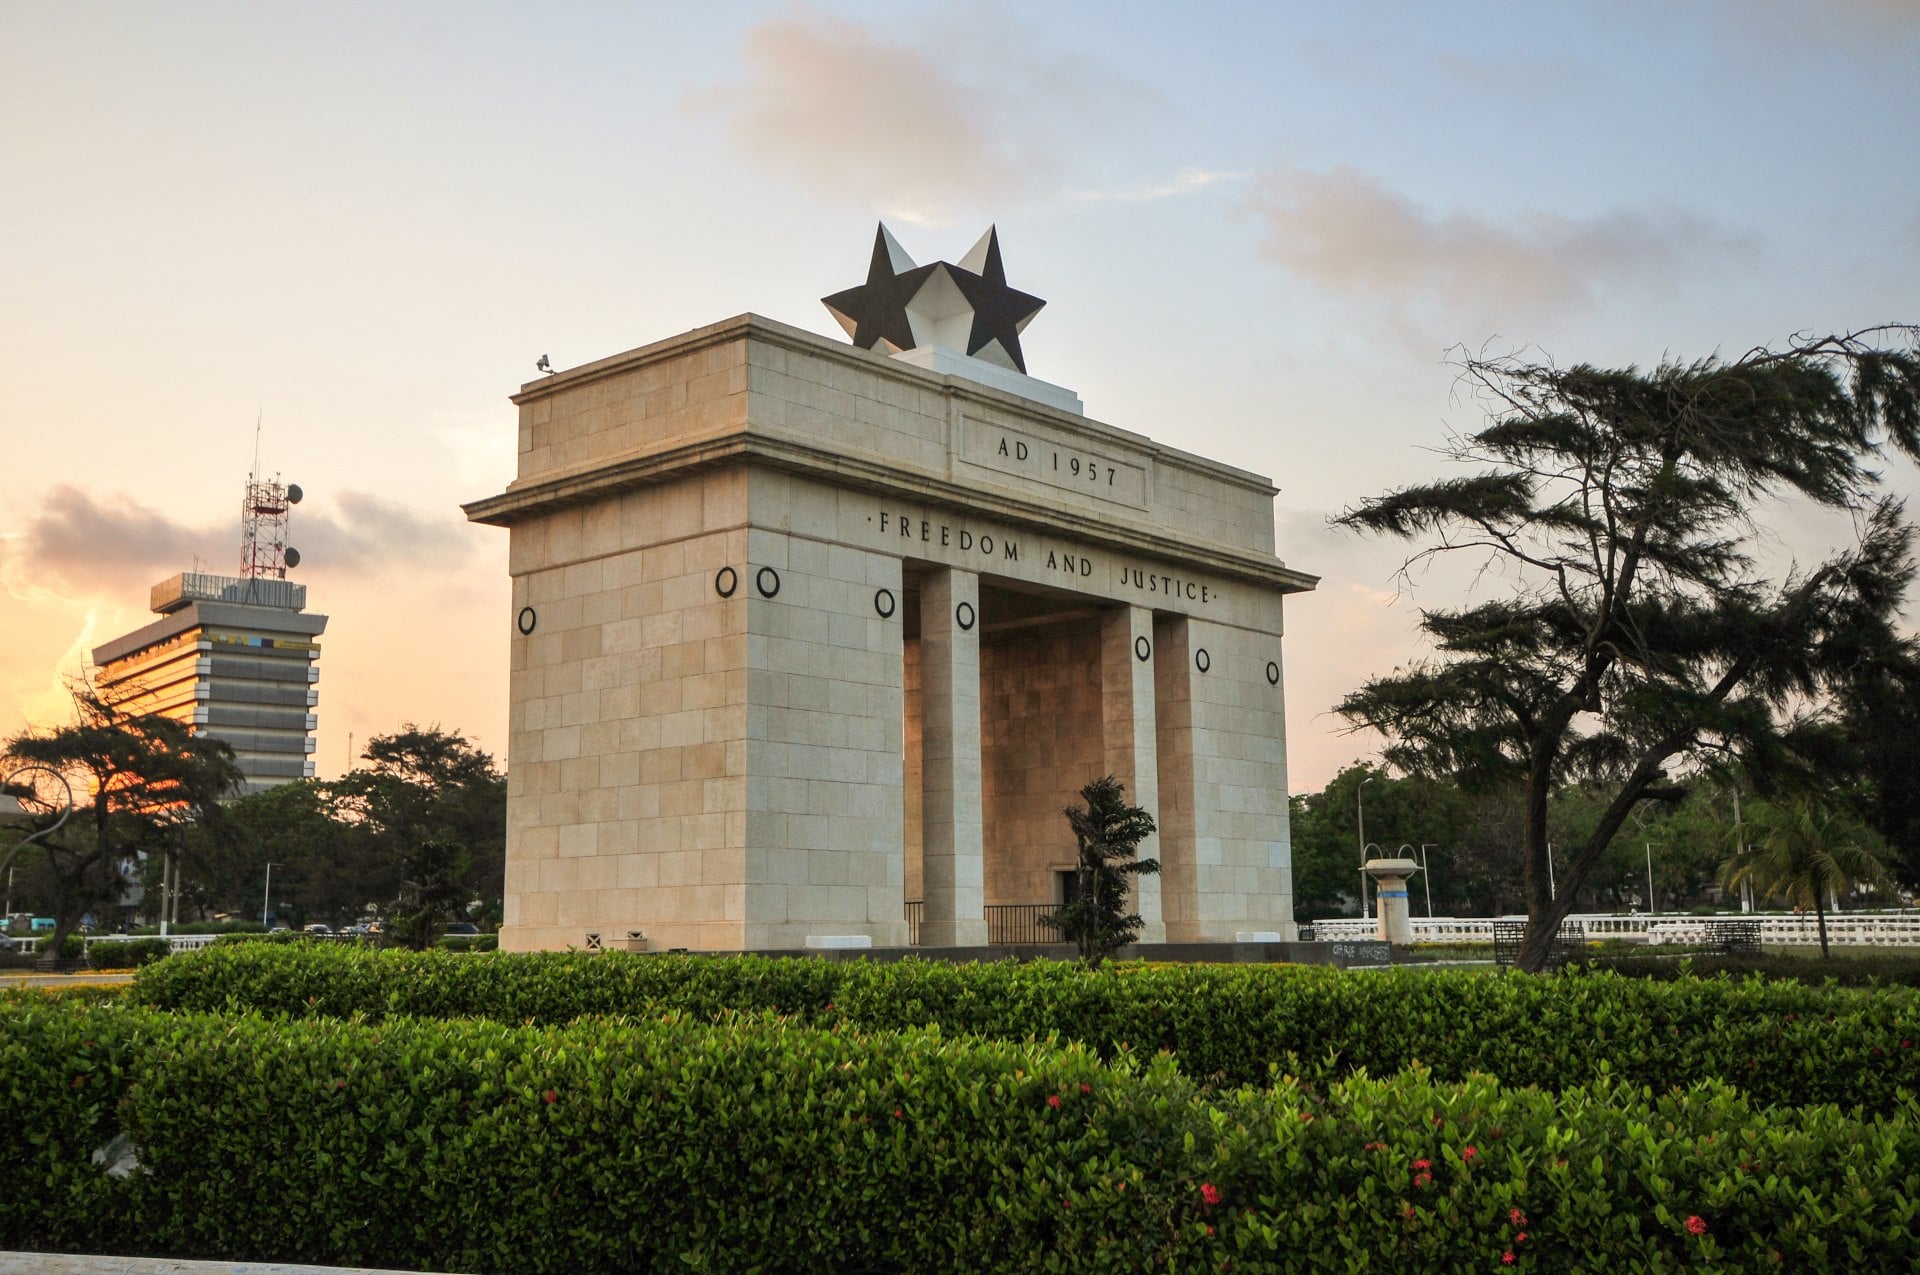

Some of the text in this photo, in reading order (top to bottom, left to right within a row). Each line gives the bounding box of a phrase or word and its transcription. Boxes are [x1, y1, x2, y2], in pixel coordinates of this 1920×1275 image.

[997, 437, 1116, 486] AD 1957
[1047, 551, 1092, 577] AND
